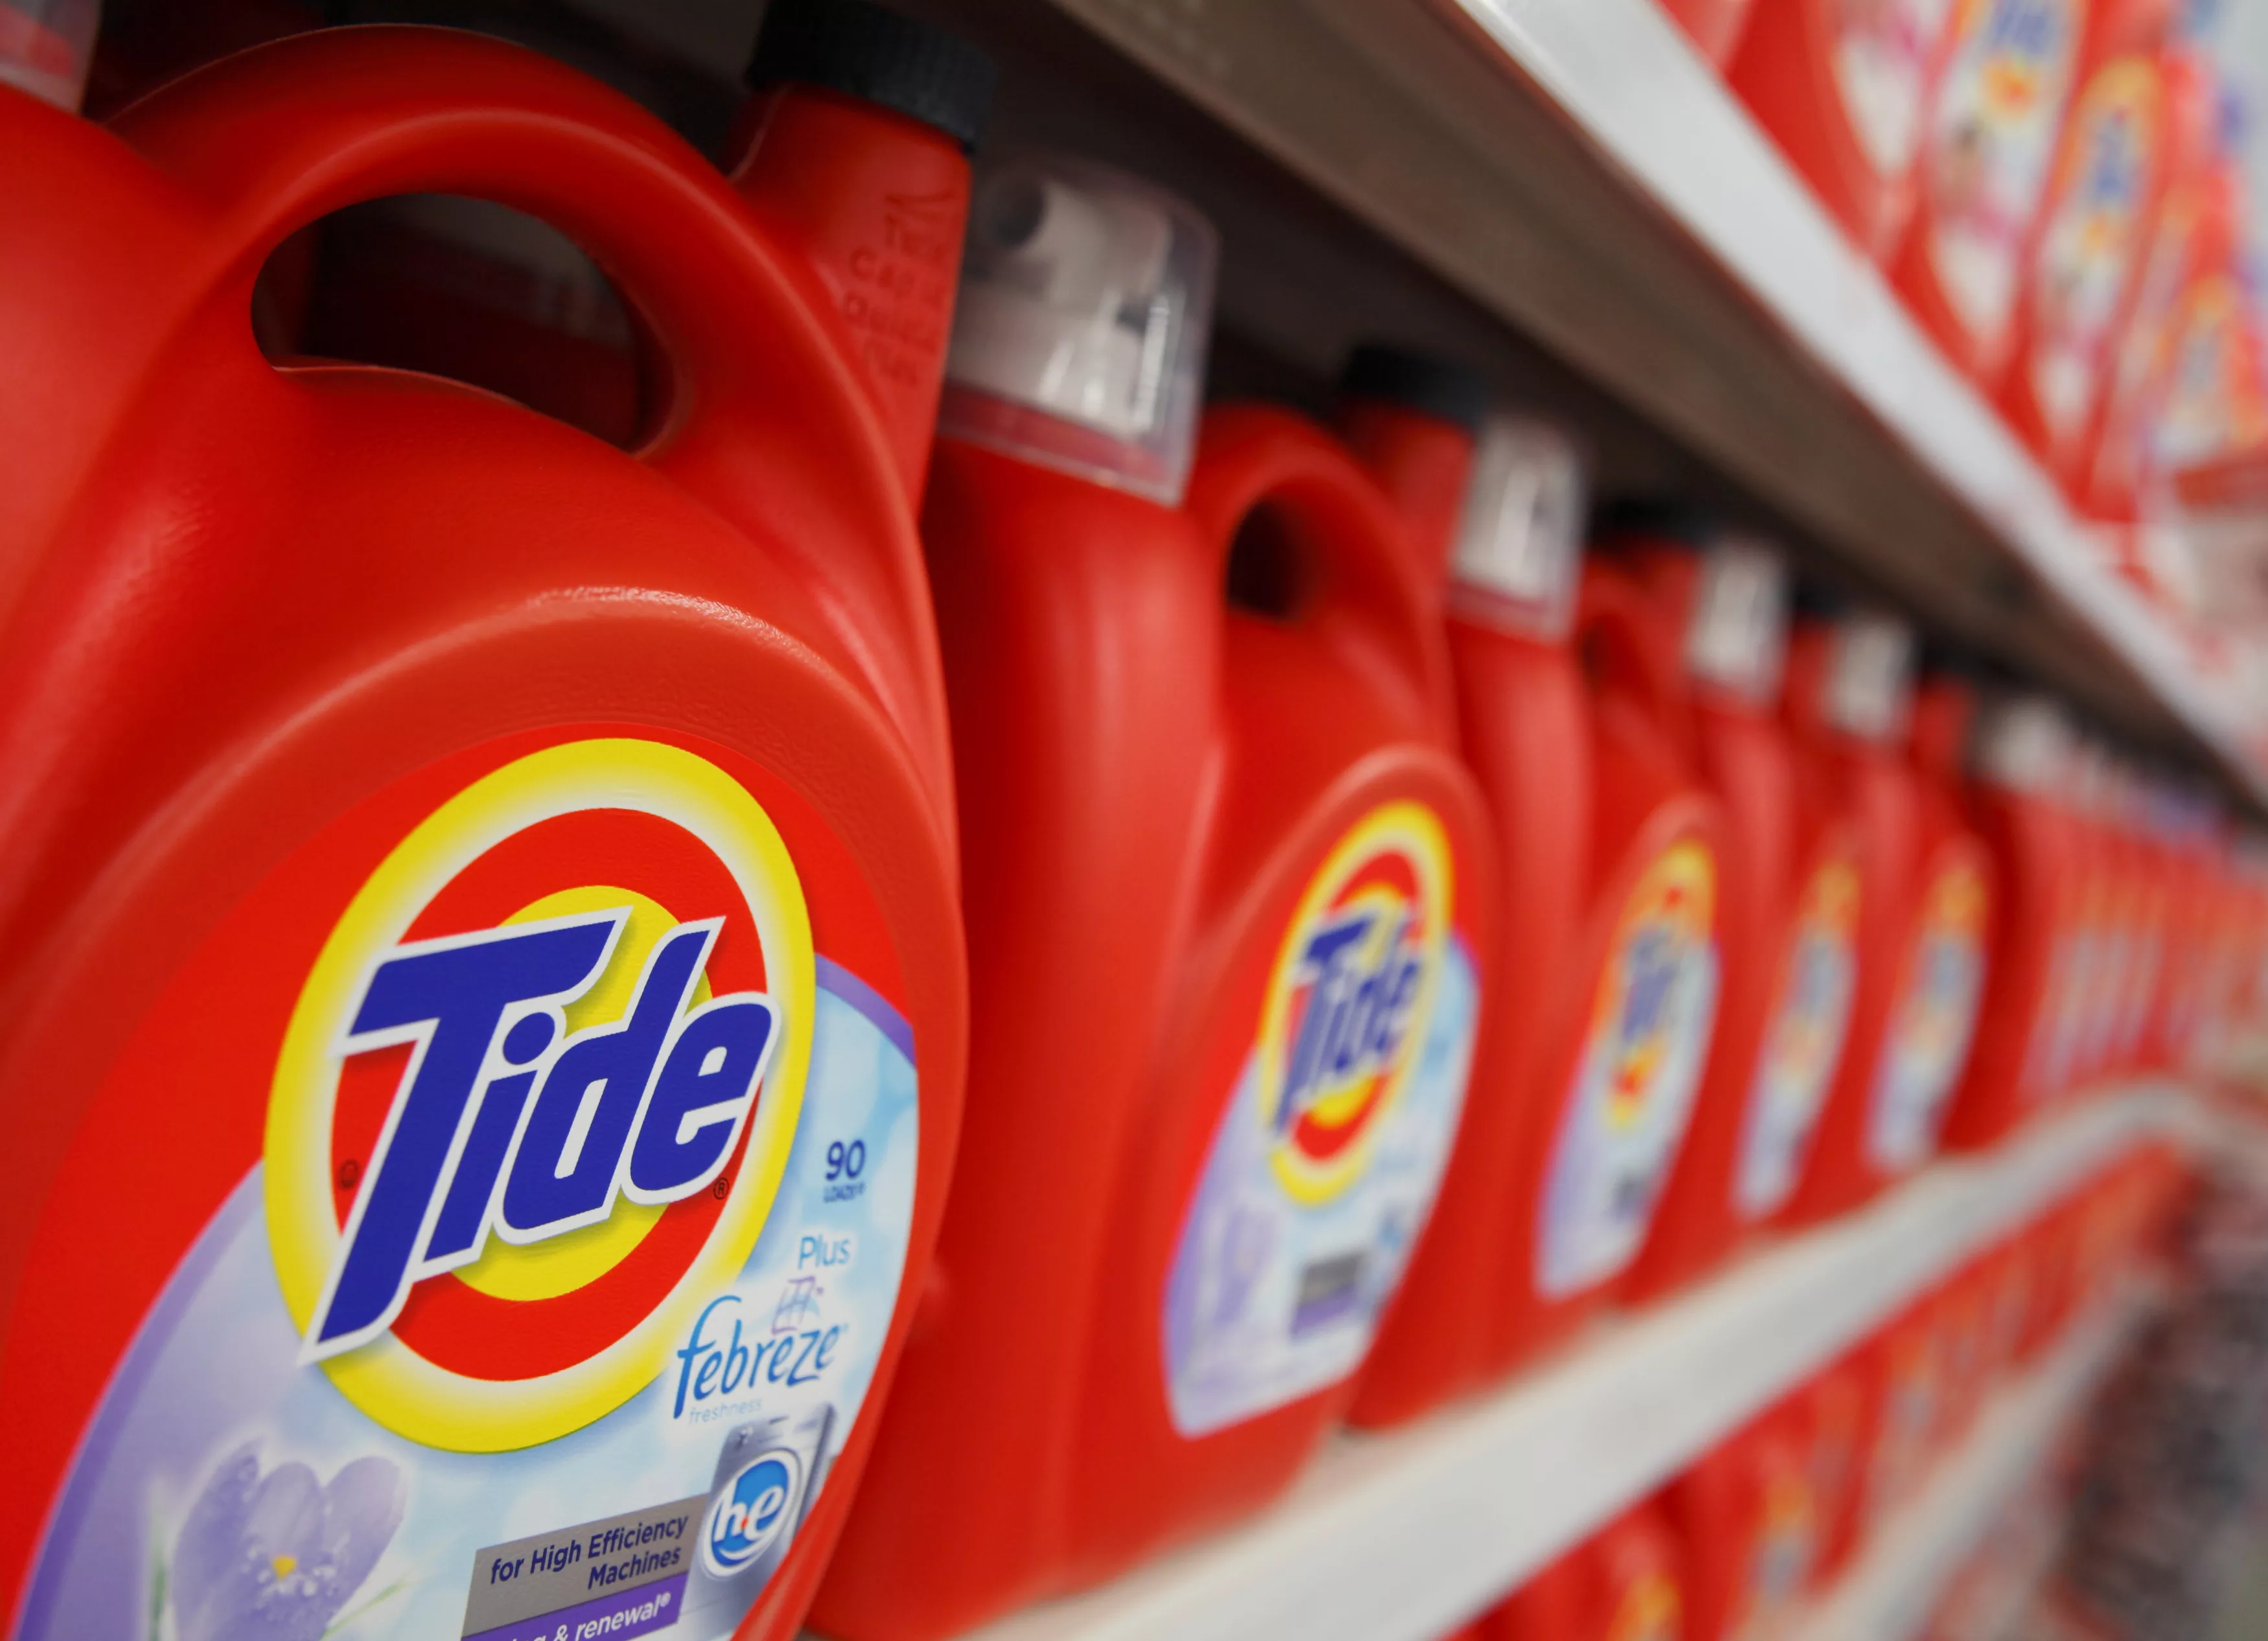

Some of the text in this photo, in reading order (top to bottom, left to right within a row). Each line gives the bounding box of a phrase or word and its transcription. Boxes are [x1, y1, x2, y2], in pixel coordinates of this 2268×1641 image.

[1271, 909, 1424, 1139] Tide
[300, 906, 780, 1362] Tide
[825, 1139, 866, 1181] 90
[798, 1234, 850, 1270] Plus
[673, 1294, 842, 1419] febreze
[689, 1398, 763, 1424] freshness
[491, 1515, 689, 1585] for High Efficiency
[587, 1546, 682, 1590] Machines
